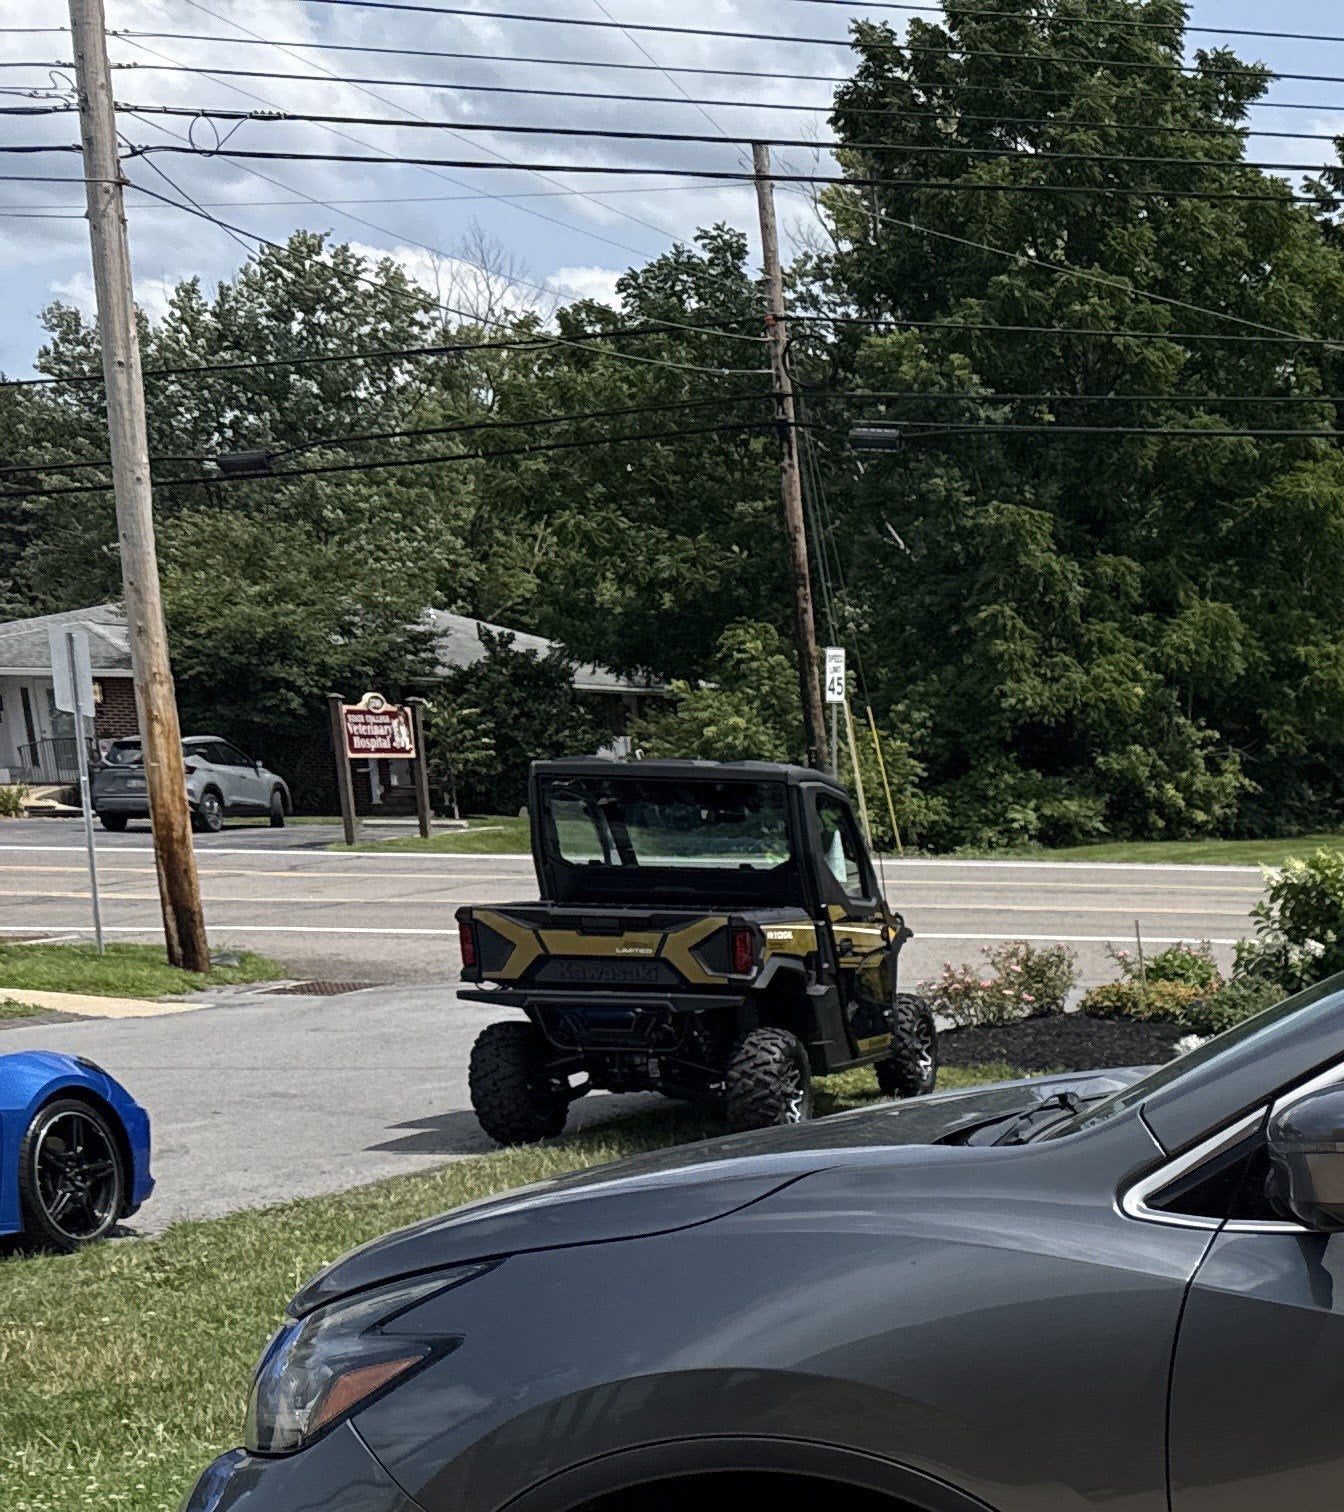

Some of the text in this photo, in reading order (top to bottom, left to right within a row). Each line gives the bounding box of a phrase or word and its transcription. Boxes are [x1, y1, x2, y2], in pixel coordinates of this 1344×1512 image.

[828, 676, 844, 696] 45
[353, 735, 391, 751] Hospital
[561, 961, 659, 983] Kawasaki
